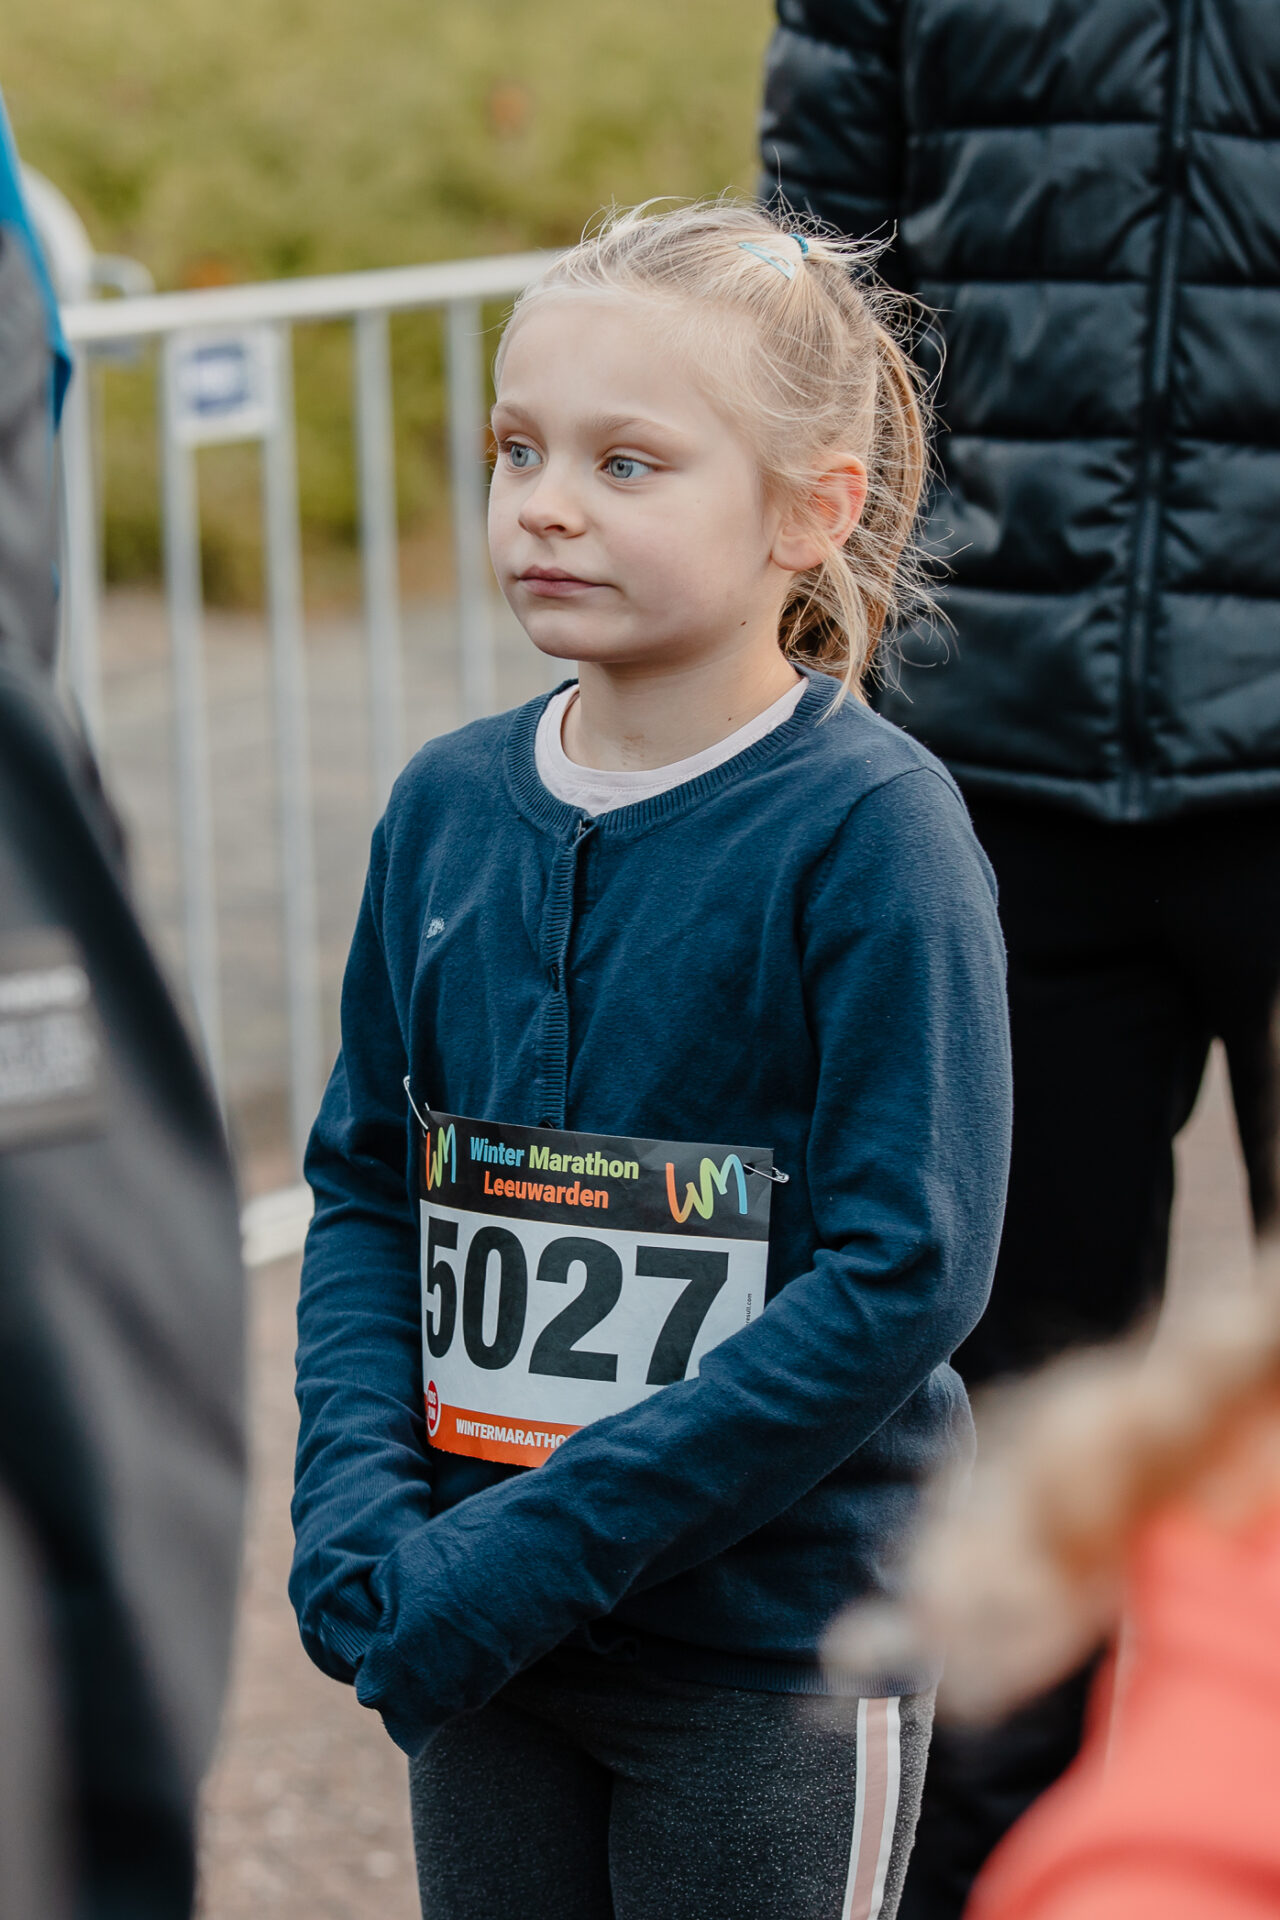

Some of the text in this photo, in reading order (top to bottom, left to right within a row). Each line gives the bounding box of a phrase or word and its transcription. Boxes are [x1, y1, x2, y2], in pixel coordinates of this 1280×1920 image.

[470, 1136, 640, 1180] Winter Marathon
[483, 1170, 609, 1209] Leeuwarden
[425, 1215, 730, 1386] 5027
[455, 1417, 571, 1449] WINTERMARATHO
